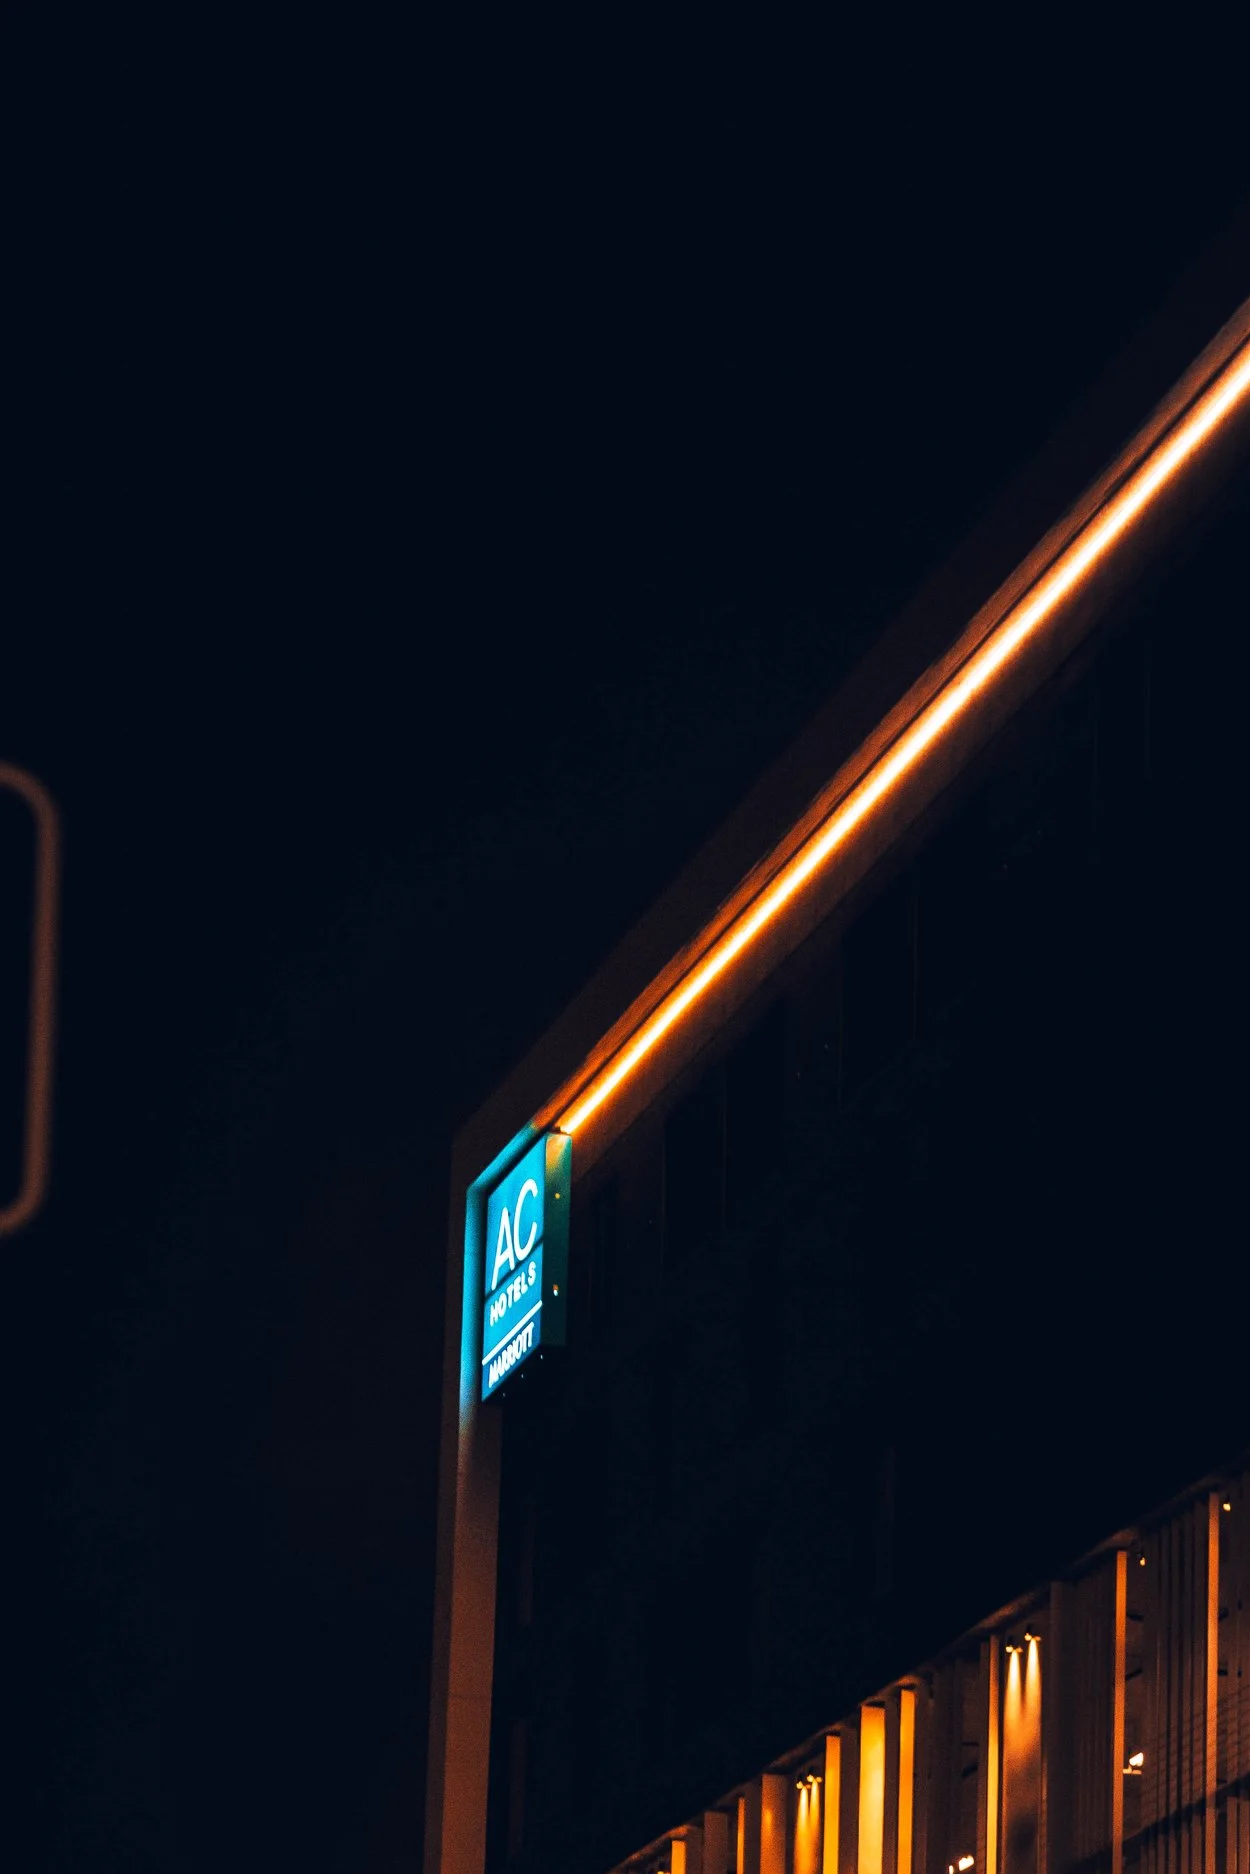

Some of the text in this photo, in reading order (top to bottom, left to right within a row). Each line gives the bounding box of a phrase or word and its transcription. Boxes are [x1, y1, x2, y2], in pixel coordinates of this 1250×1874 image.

[490, 1178, 538, 1291] AC
[490, 1261, 537, 1327] HOTELS
[488, 1322, 535, 1388] MARRIOTT
